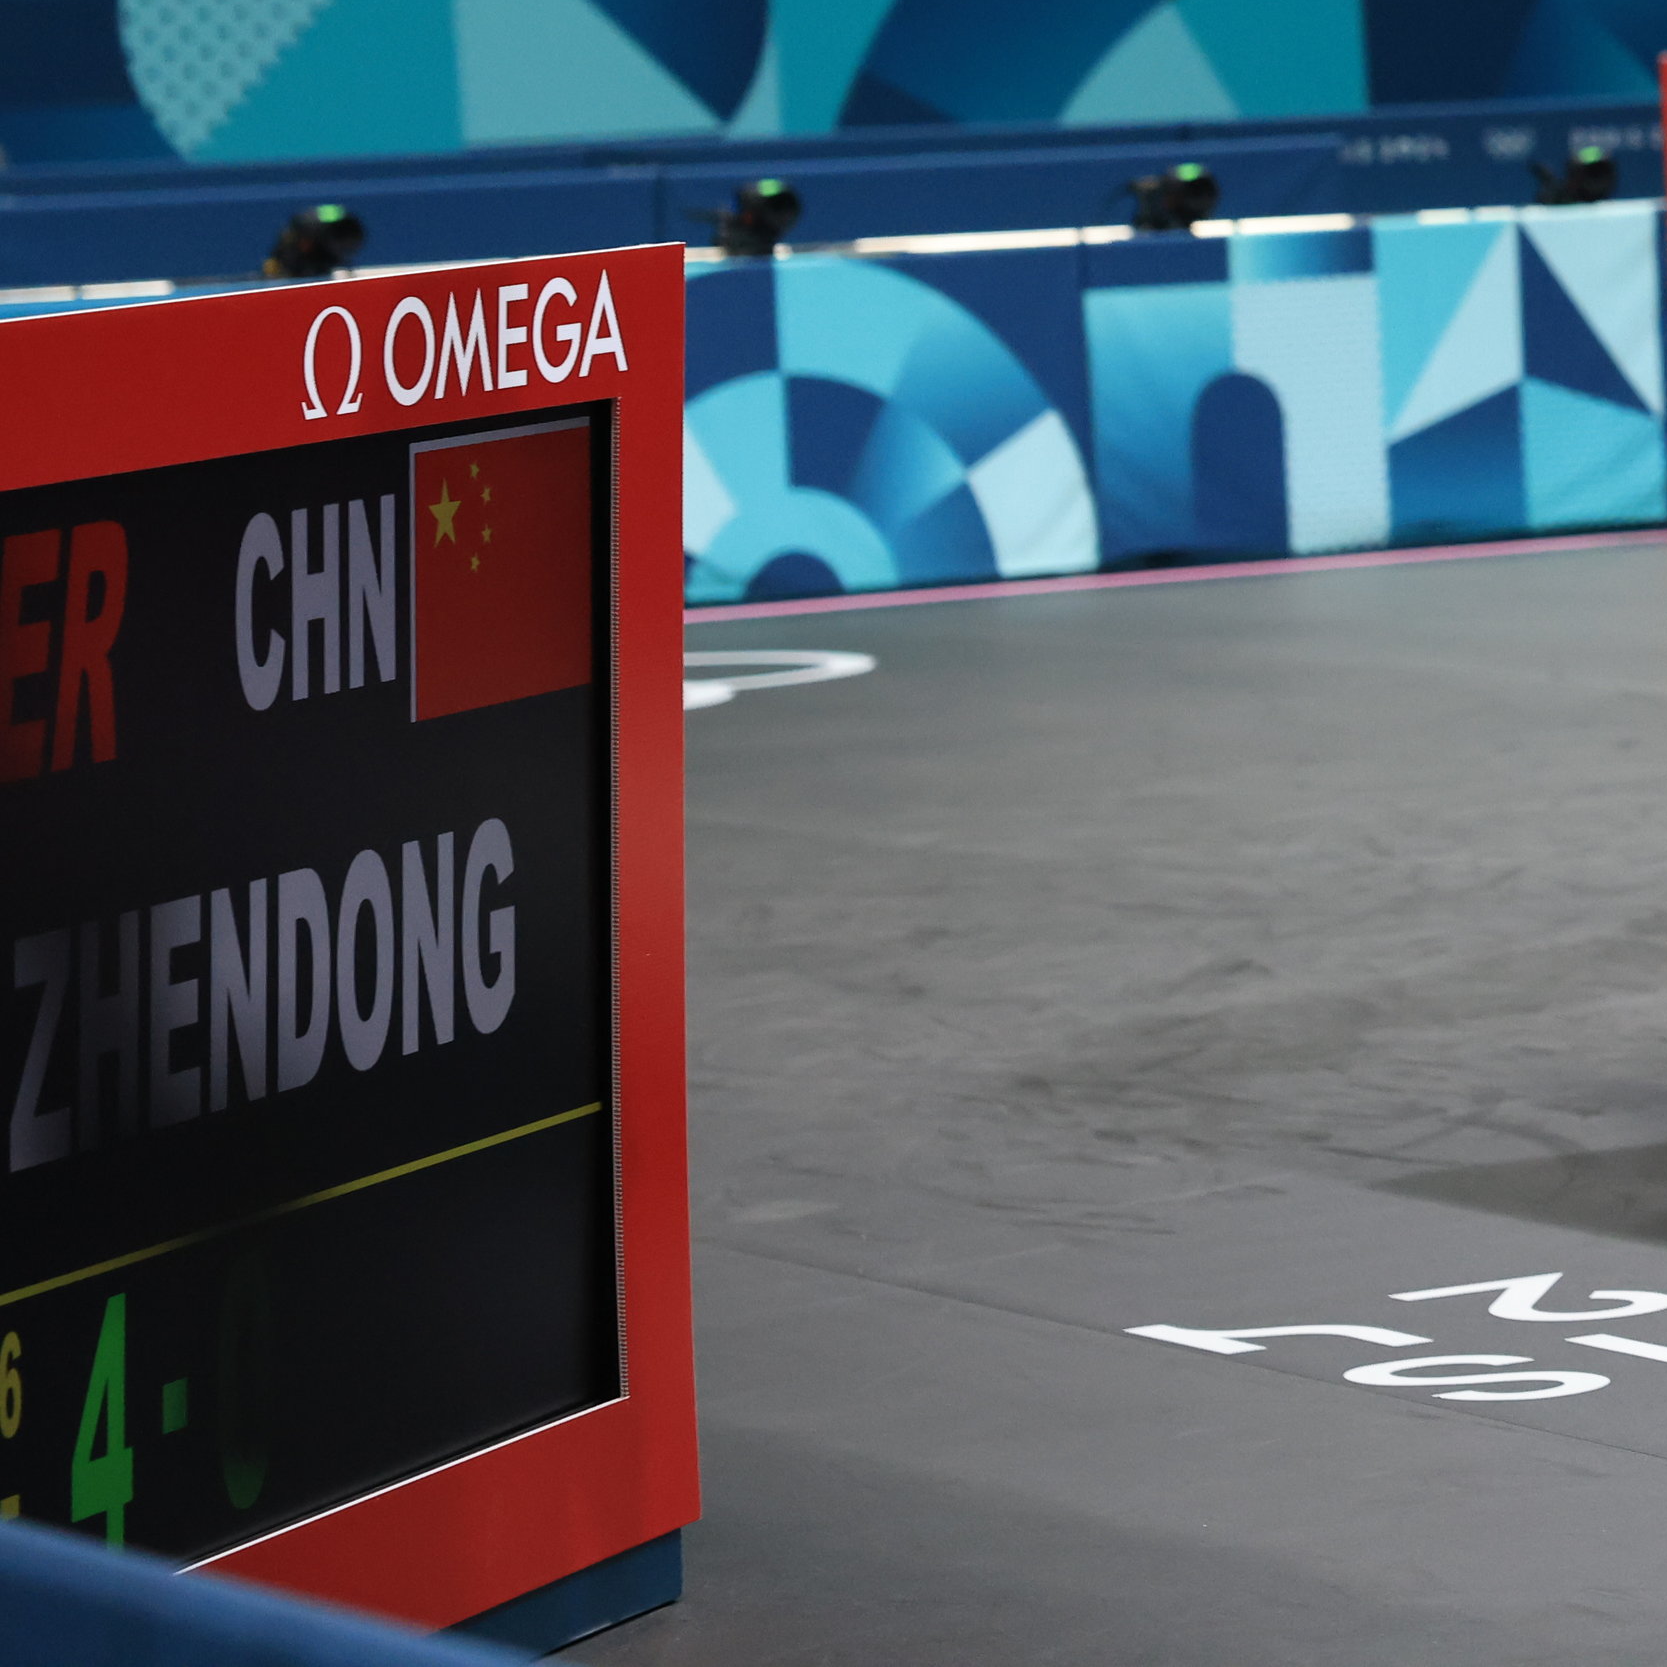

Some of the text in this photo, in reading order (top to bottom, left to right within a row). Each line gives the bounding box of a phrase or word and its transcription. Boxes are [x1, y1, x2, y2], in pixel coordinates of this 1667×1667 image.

[383, 270, 629, 406] OMEGA
[235, 493, 397, 712] CHN
[9, 817, 517, 1174] ZHENDONG
